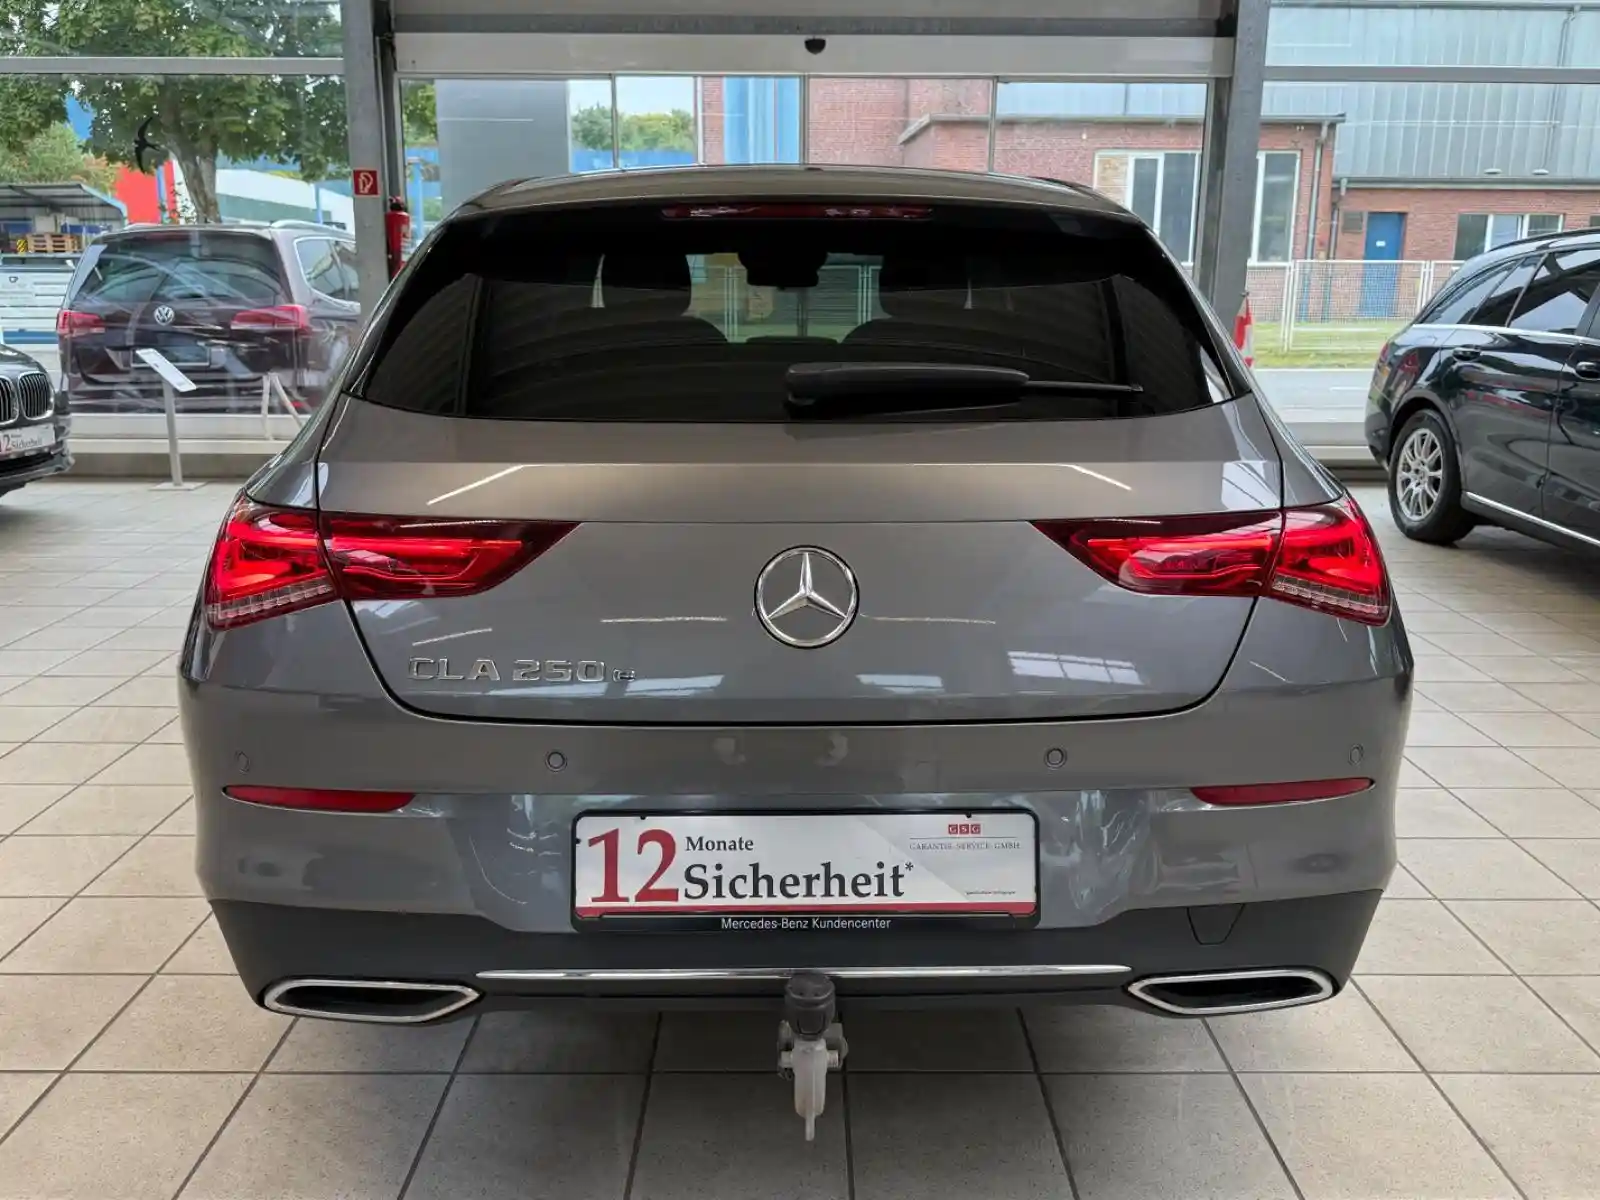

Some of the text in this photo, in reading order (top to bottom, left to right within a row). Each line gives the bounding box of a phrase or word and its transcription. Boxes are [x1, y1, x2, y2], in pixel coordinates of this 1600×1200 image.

[408, 656, 501, 682] CLA
[685, 835, 755, 852] Monate
[588, 828, 679, 902] 12
[721, 916, 892, 930] Mercedes-Benz Kundencenter
